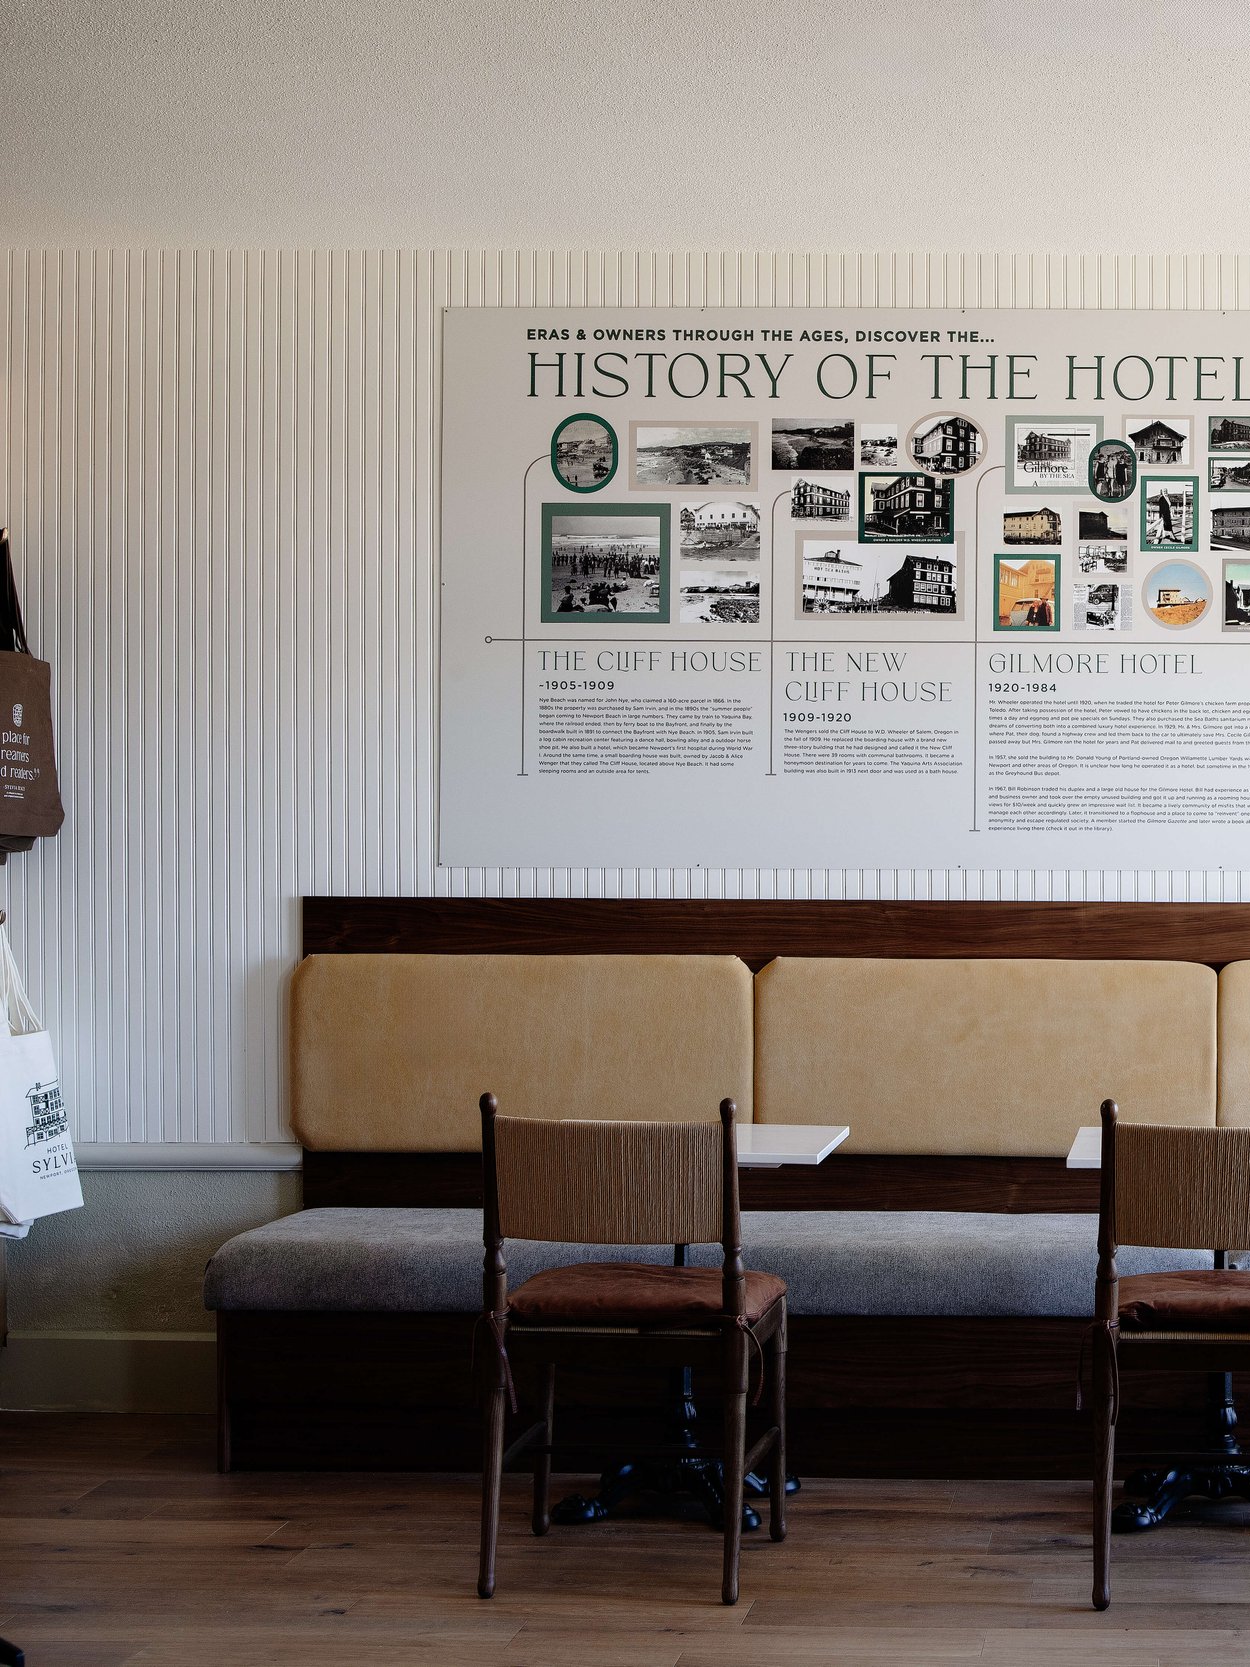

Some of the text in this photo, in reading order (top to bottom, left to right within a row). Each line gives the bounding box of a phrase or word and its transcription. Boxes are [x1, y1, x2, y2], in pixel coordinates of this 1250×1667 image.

[527, 329, 994, 343] ERAS & OWNERS THROUGH THE AGES, DISCOVER THE...
[527, 353, 794, 398] HISTORY
[817, 354, 897, 399] OF
[921, 355, 1037, 399] THE
[1023, 461, 1068, 473] Gilmore
[538, 651, 761, 672] THE CLIFF HOUSE
[786, 652, 906, 672] THE NEW
[989, 653, 1202, 674] GILMORE HOTEL
[539, 681, 614, 690] ~1905-1909
[786, 681, 951, 702] CLIFF HOUSE
[989, 683, 1056, 692] 1920-1984
[784, 713, 851, 722] 1909-1920
[2, 730, 22, 745] place
[0, 749, 30, 763] reamers
[47, 1143, 68, 1154] HOTEL
